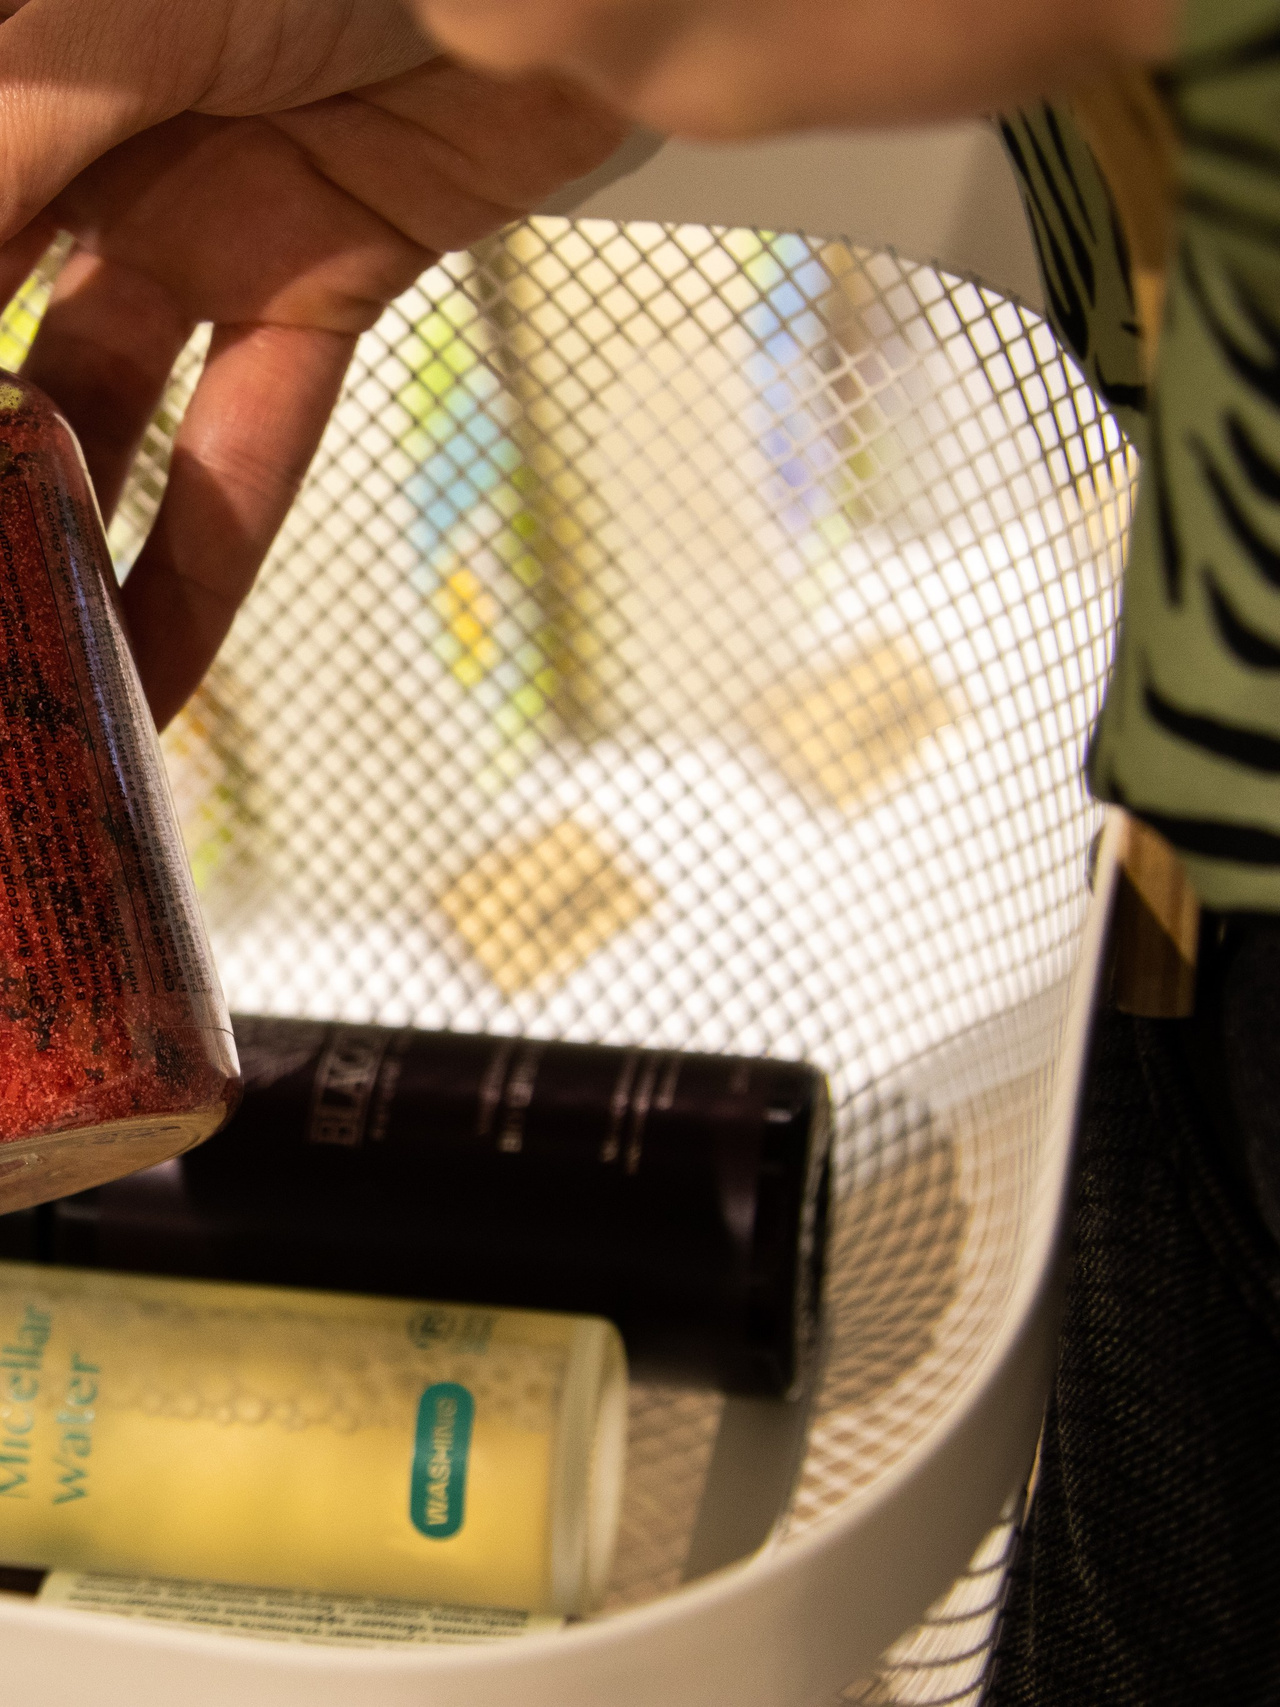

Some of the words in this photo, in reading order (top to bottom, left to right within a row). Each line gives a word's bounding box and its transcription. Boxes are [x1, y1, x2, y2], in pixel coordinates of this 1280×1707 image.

[38, 479, 63, 553] баночки
[58, 555, 75, 602] треть
[9, 729, 42, 824] заживляет
[30, 735, 51, 781] Сода
[53, 749, 73, 792] соль
[4, 792, 31, 865] чайного
[65, 797, 93, 873] морская
[23, 867, 46, 922] масло
[12, 912, 33, 958] микс
[37, 924, 67, 1005] эфирное
[47, 879, 87, 987] разогретую
[78, 921, 106, 998] миндаля
[152, 923, 176, 993] Способ
[24, 962, 46, 1011] Этот
[75, 990, 88, 1001] в
[104, 949, 125, 996] чают
[52, 1352, 101, 1506] Water
[425, 1396, 459, 1526] WASHING
